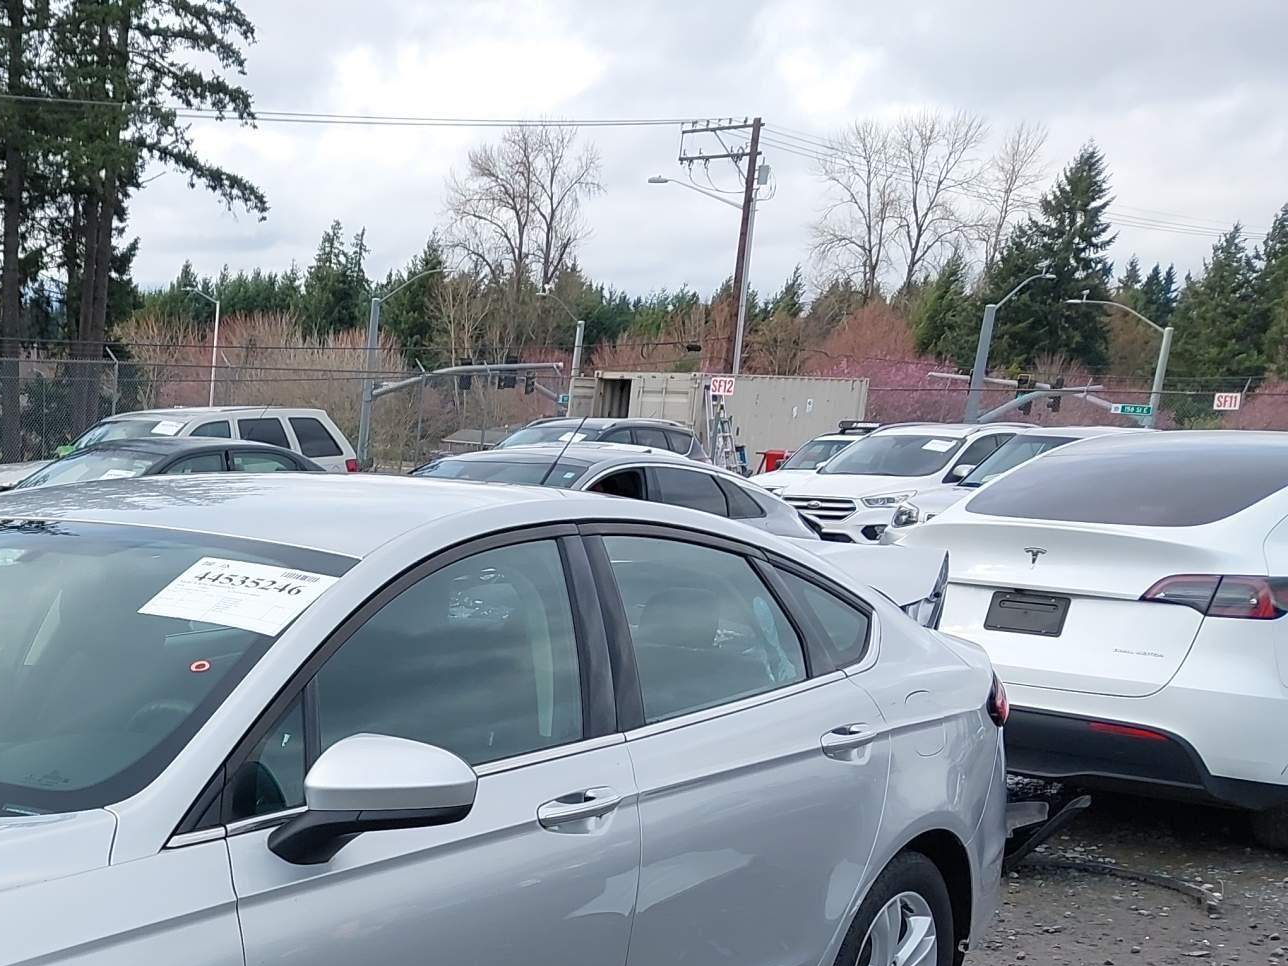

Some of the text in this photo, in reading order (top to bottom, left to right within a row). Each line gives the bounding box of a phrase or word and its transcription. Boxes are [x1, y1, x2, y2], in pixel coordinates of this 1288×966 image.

[712, 379, 733, 393] SF12
[1216, 394, 1238, 408] SF11
[194, 571, 303, 596] 44535246
